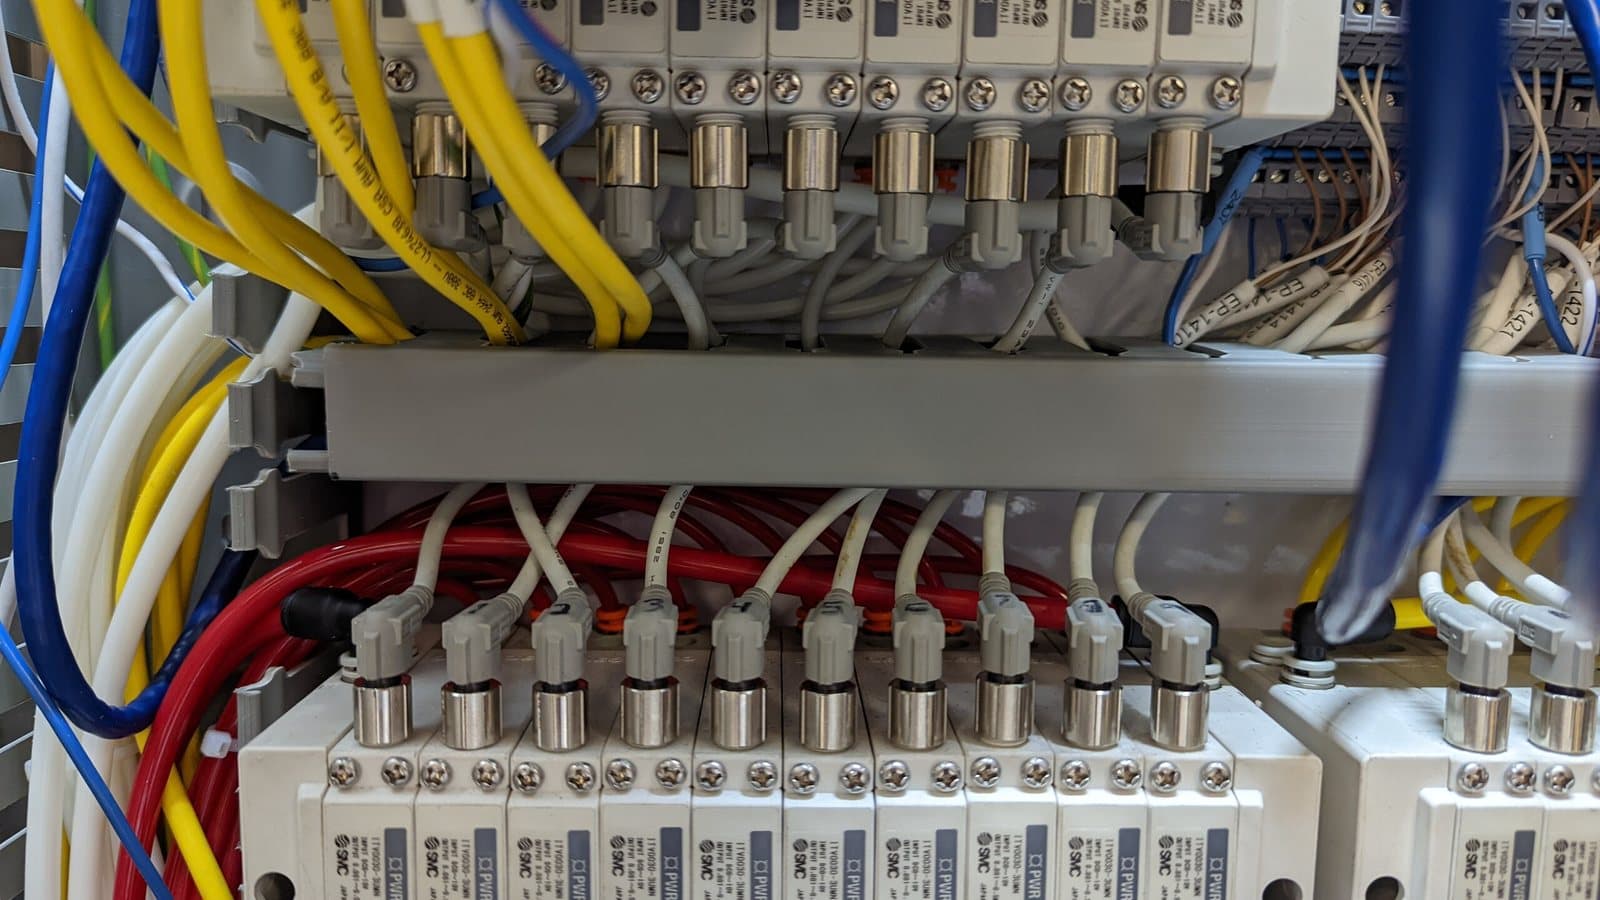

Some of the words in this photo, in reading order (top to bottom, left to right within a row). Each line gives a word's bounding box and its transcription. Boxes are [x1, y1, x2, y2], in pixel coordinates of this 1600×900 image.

[336, 849, 349, 876] SMC
[427, 851, 440, 878] SMC
[519, 852, 532, 879] SMC
[612, 850, 624, 877] SMC
[700, 855, 713, 881] SMC
[794, 853, 807, 880] SMC
[887, 852, 900, 879] SMC
[978, 847, 991, 874] SMC
[1070, 851, 1082, 878] SMC
[1160, 850, 1172, 877] SMC
[1465, 854, 1478, 880] SMC
[1553, 854, 1566, 880] SMC
[1028, 870, 1042, 898] PWR
